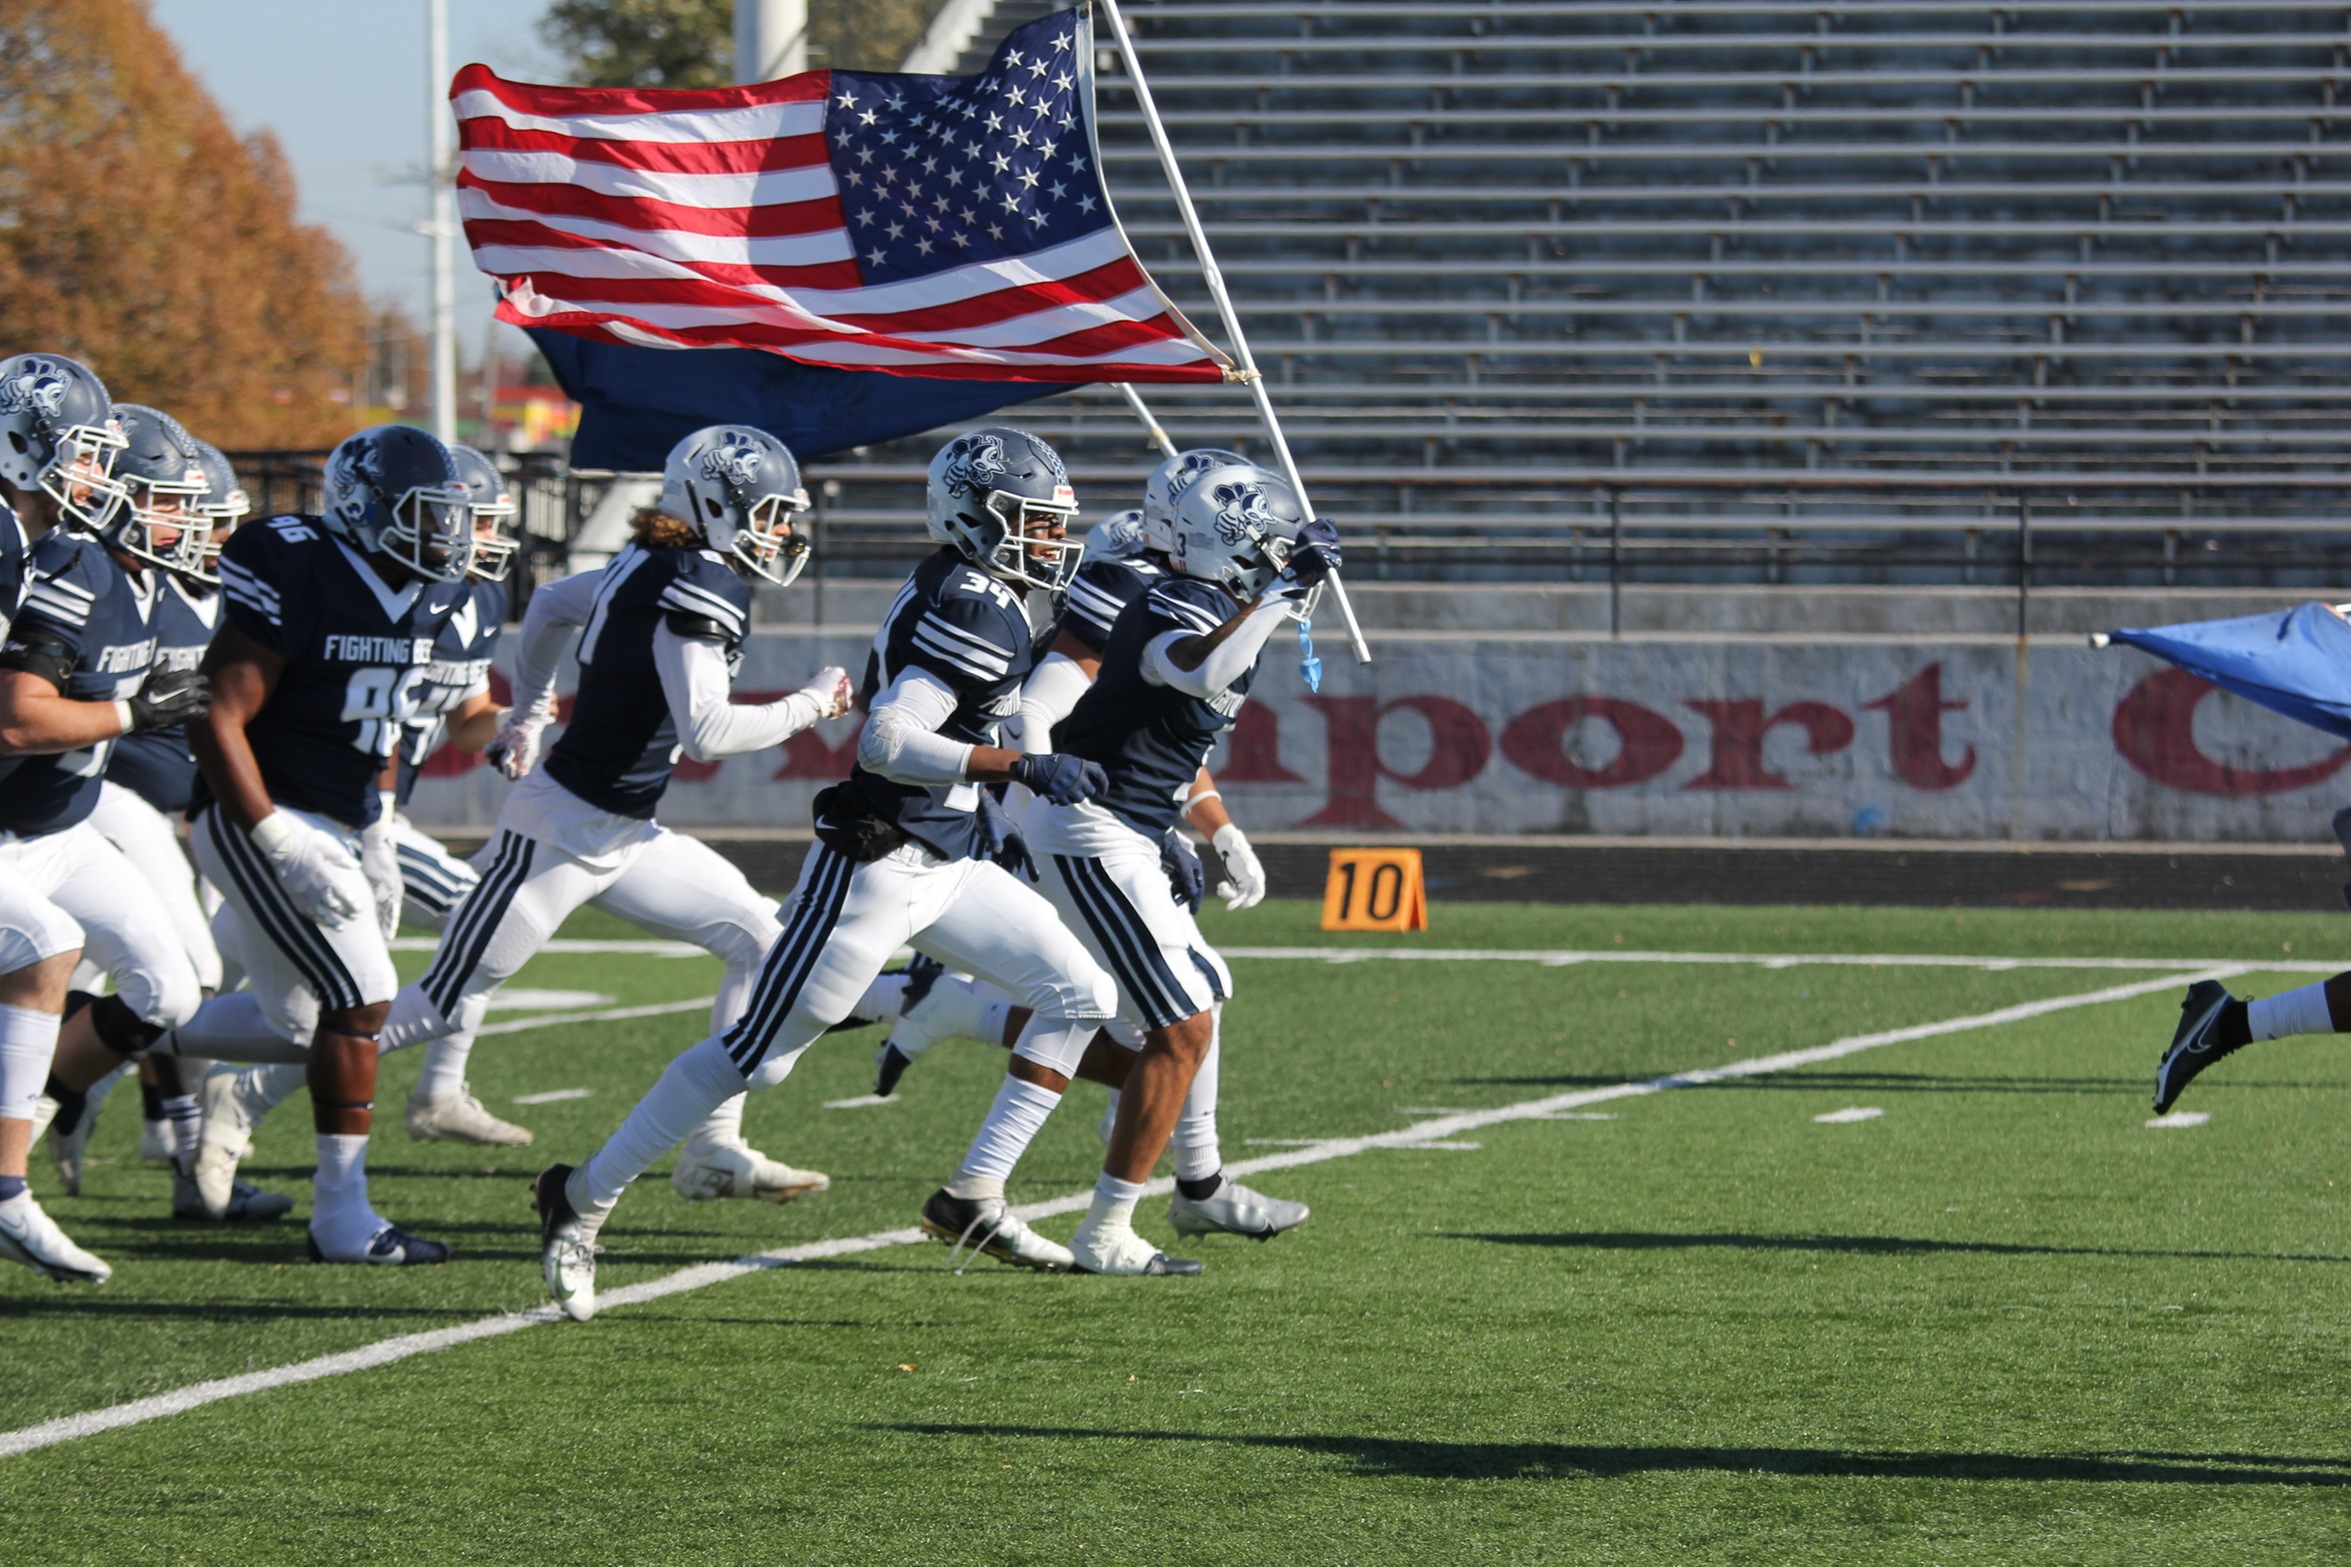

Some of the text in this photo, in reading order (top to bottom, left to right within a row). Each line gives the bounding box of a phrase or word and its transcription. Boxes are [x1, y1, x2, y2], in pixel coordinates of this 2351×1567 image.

[960, 571, 1011, 609] 34
[324, 634, 411, 664] FIGHTING
[1340, 863, 1402, 921] 10
